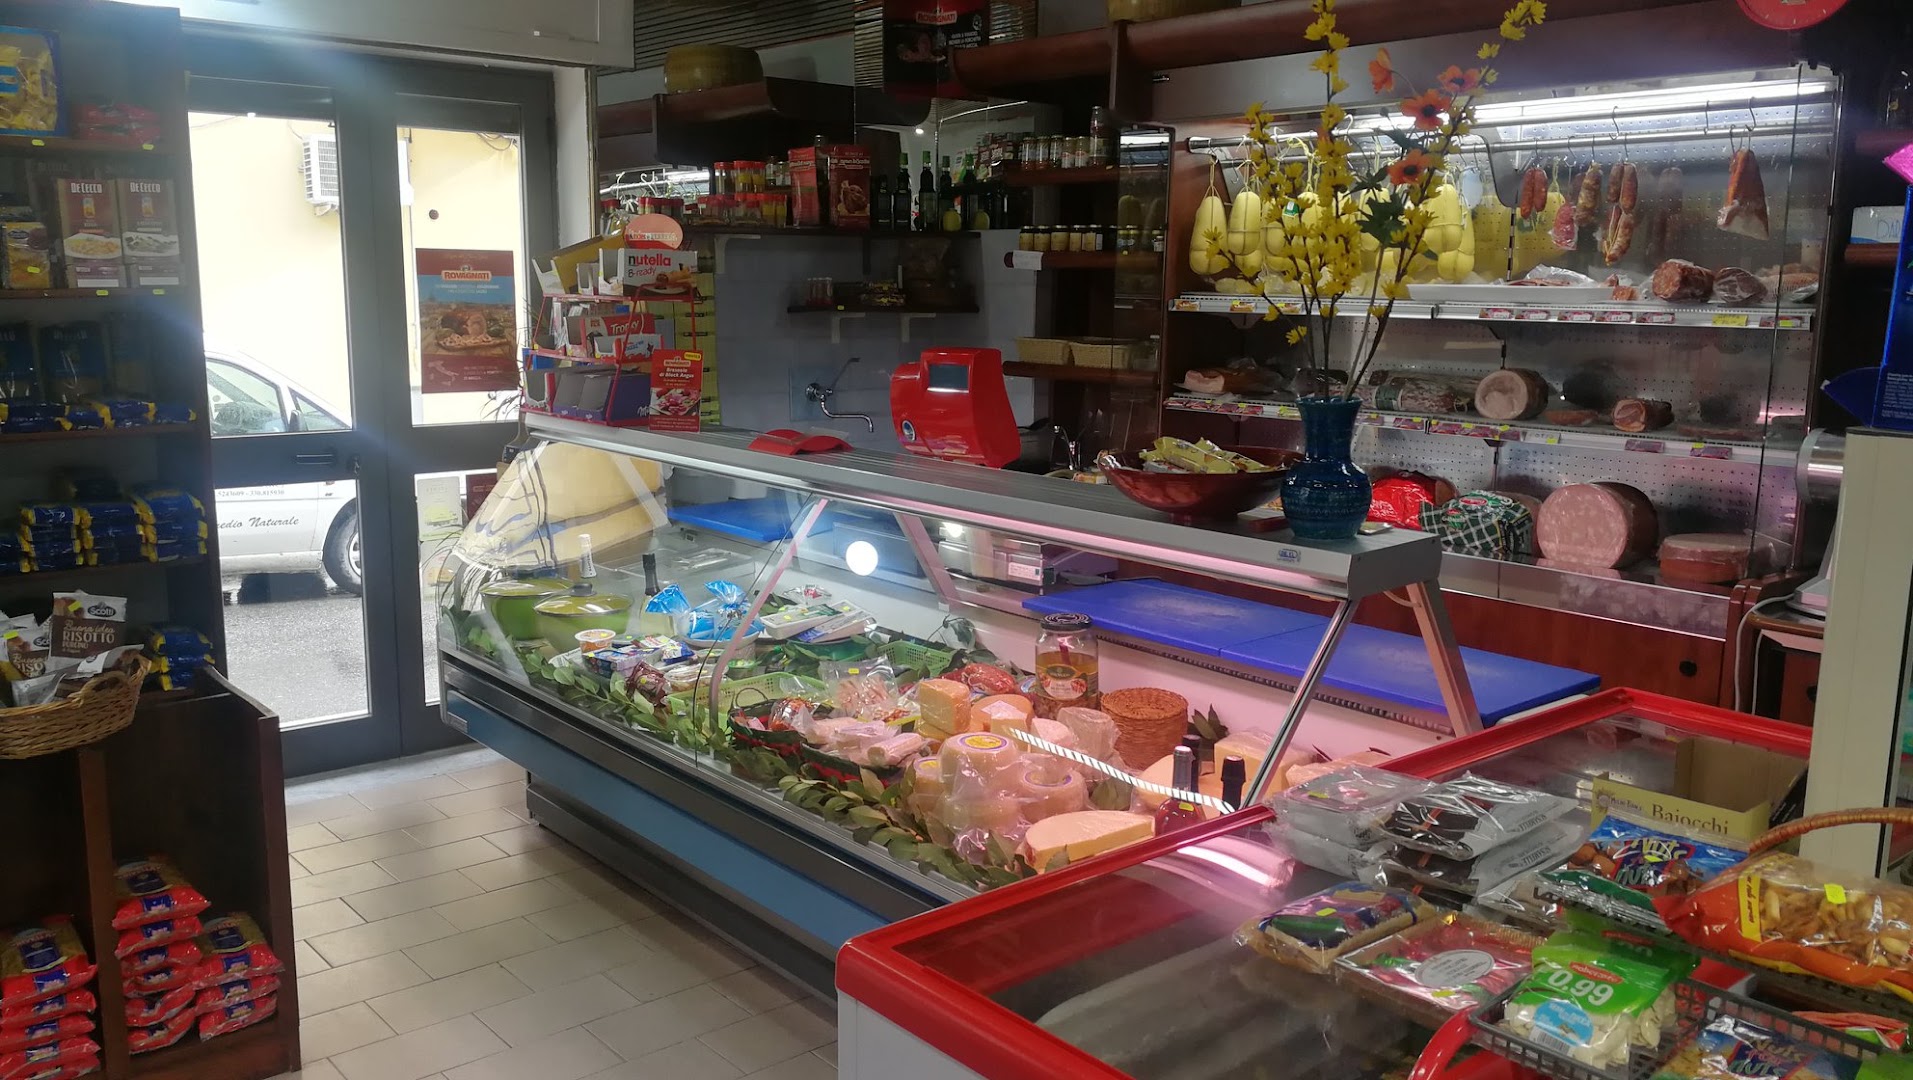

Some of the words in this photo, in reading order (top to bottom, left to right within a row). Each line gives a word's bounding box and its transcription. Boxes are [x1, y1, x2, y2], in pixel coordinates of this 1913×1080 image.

[628, 254, 671, 266] nutella
[444, 271, 490, 280] ROVAGNATI
[249, 516, 299, 528] Naturale
[90, 607, 114, 616] Scotti
[63, 619, 94, 633] Buona
[62, 631, 115, 644] RISOTTO
[1652, 803, 1729, 835] Baiocchi
[1548, 970, 1614, 1006] 0.99
